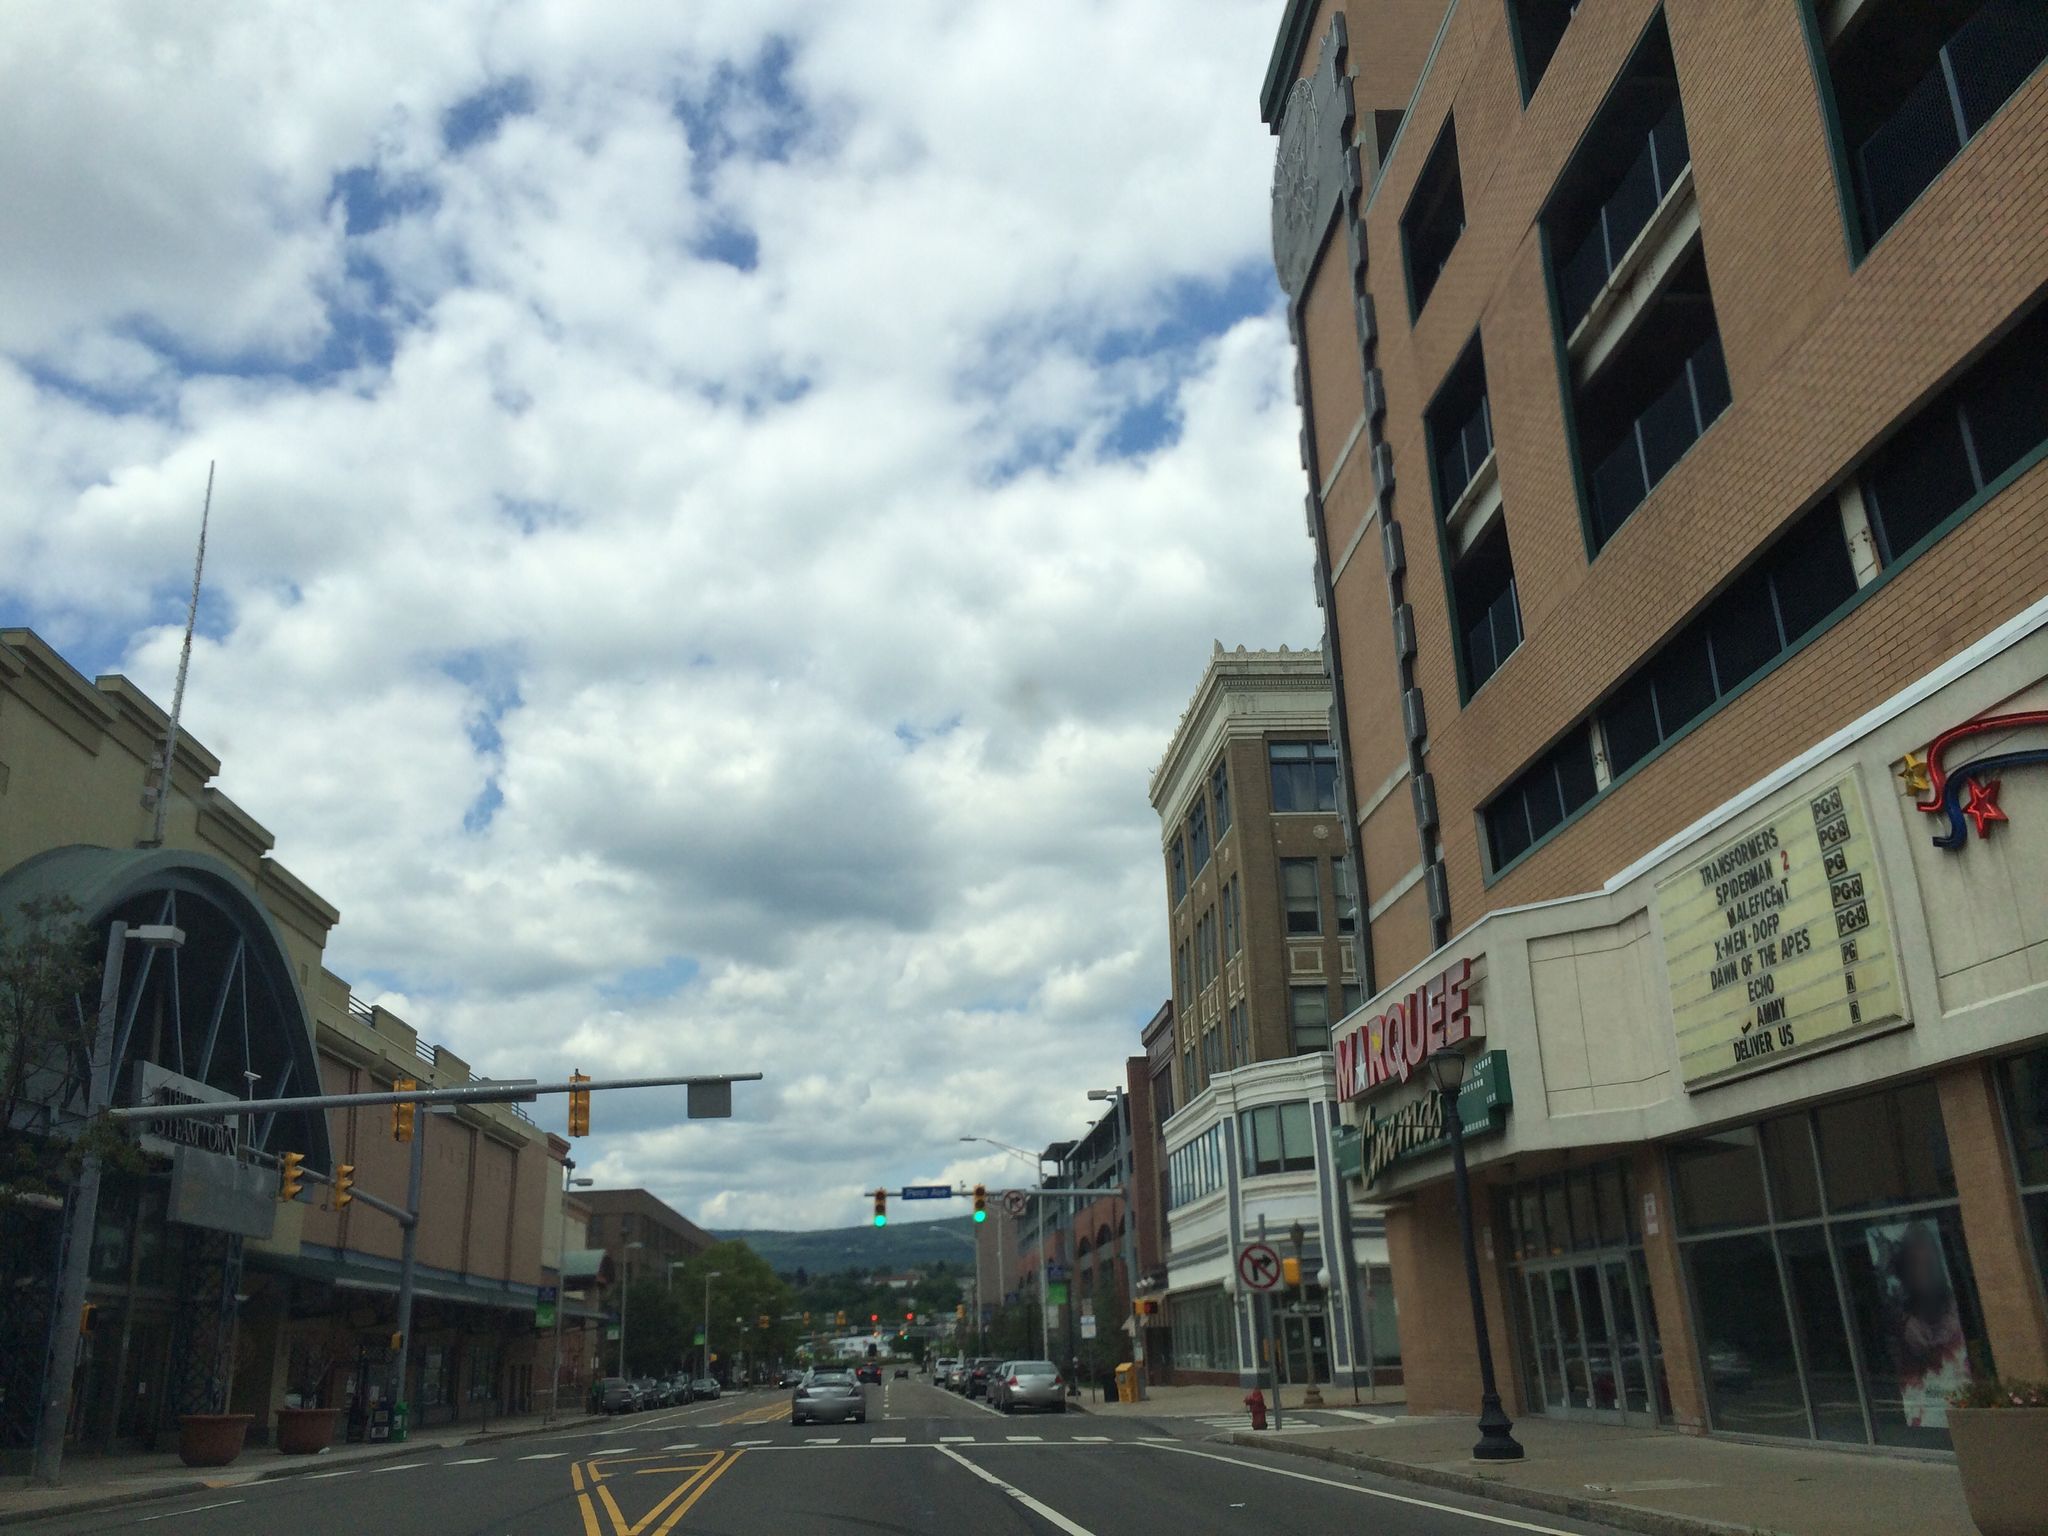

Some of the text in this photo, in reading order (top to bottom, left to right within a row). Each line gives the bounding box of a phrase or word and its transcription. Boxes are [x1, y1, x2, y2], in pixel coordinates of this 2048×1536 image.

[1700, 827, 1778, 886] TRANSFORMERS
[1716, 858, 1773, 906] SPIDERMAN
[1781, 850, 1790, 871] 2
[1727, 853, 1844, 929] MALEFICENT PG
[1710, 961, 1738, 990] DAWN
[1741, 954, 1753, 976] OF
[1757, 943, 1777, 969] THE
[1781, 928, 1810, 960] APES
[1747, 942, 1856, 1002] ECHO PG
[1336, 958, 1470, 1104] MARQUEE
[1733, 1031, 1774, 1062] DELIVER
[1778, 1024, 1794, 1047] US
